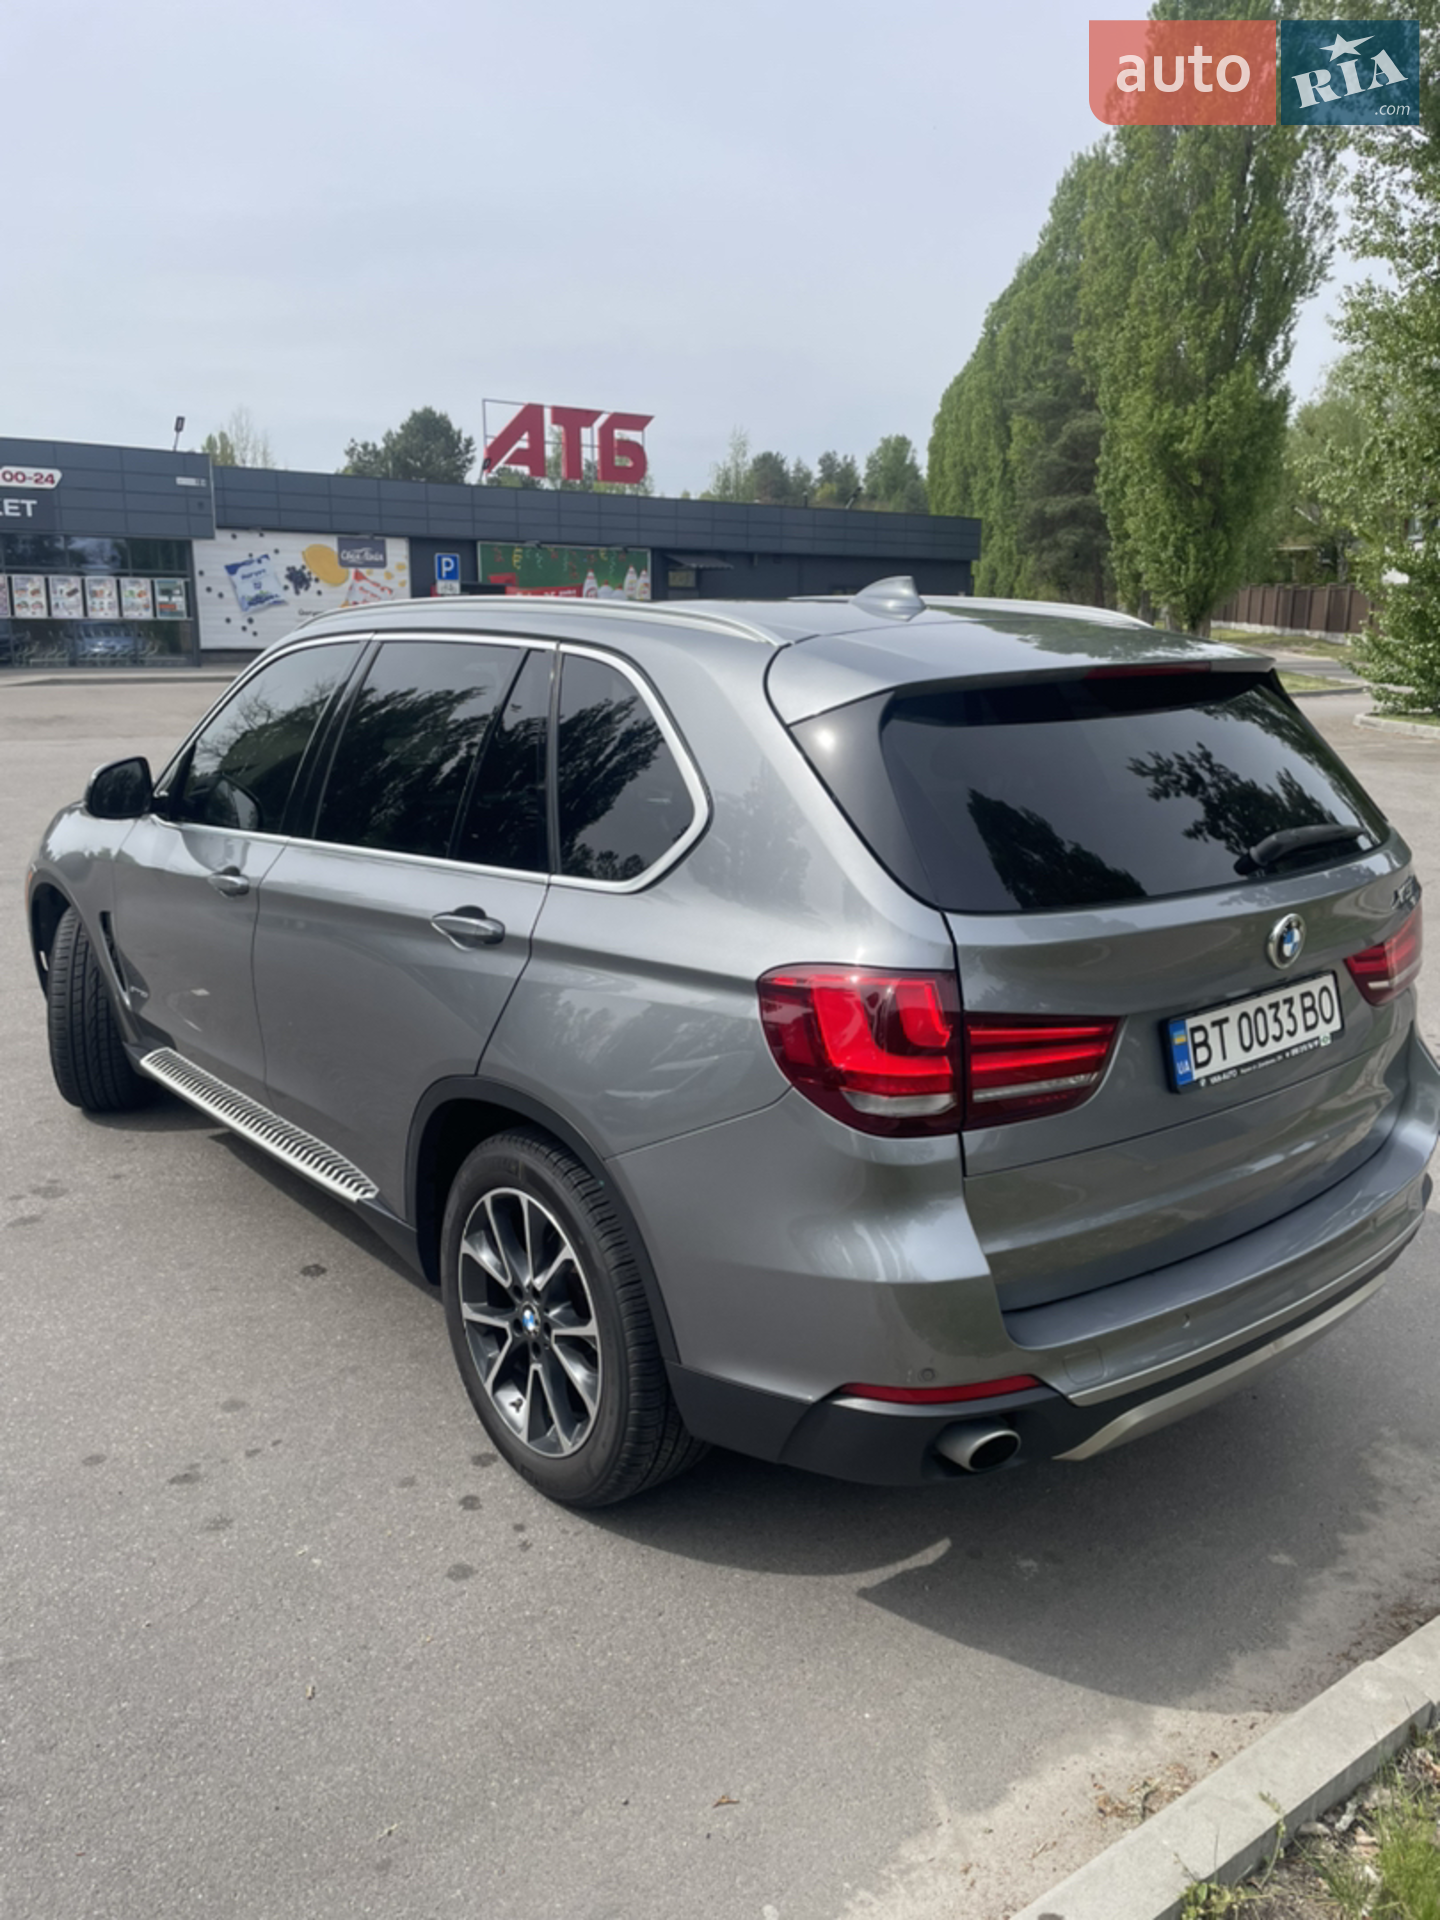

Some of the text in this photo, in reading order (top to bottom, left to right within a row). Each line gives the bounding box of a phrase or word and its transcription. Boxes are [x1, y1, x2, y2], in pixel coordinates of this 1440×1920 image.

[484, 403, 655, 484] АТБ
[0, 498, 38, 517] ET
[441, 557, 455, 579] P
[1189, 984, 1335, 1070] BT 0033 BO
[1176, 1060, 1191, 1076] UA
